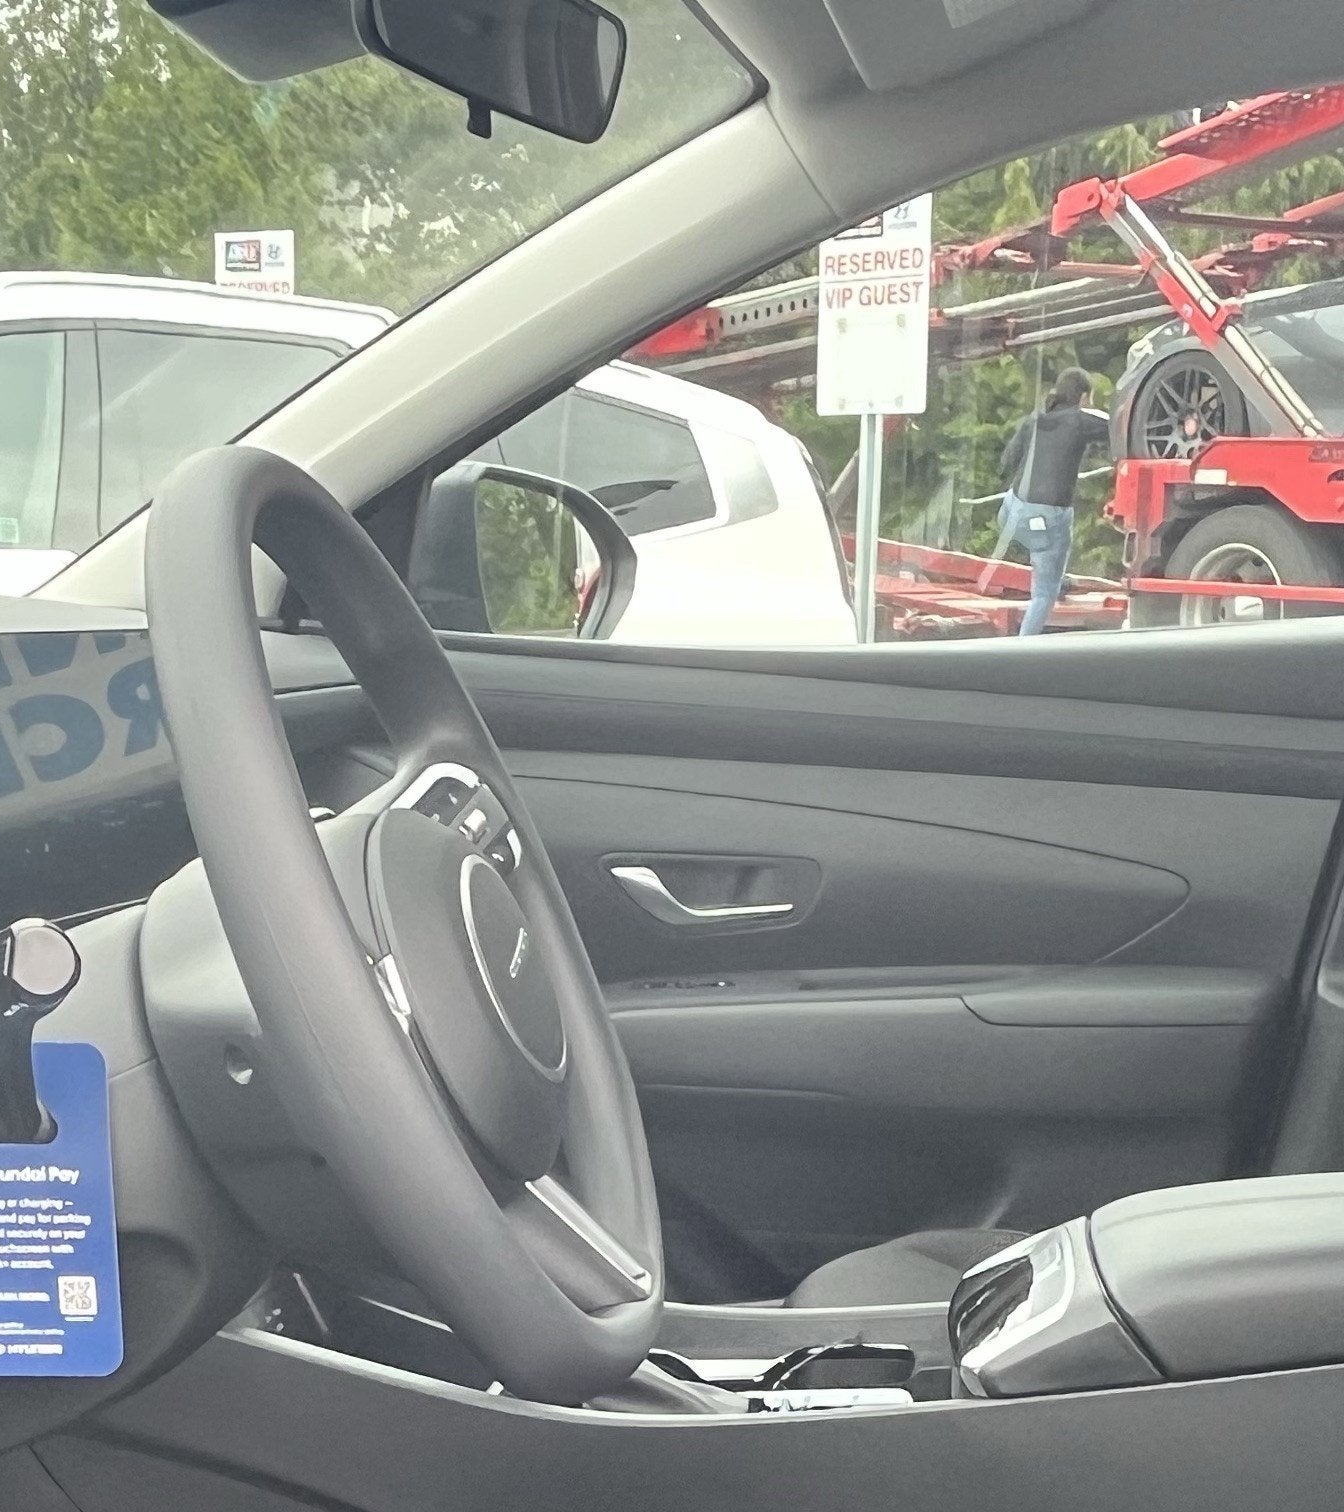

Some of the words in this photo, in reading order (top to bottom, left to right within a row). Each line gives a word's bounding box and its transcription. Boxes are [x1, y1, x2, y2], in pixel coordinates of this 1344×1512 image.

[824, 247, 924, 276] RESERVED
[826, 287, 853, 309] VIP
[859, 281, 924, 306] GUEST
[48, 1165, 81, 1185] Pay
